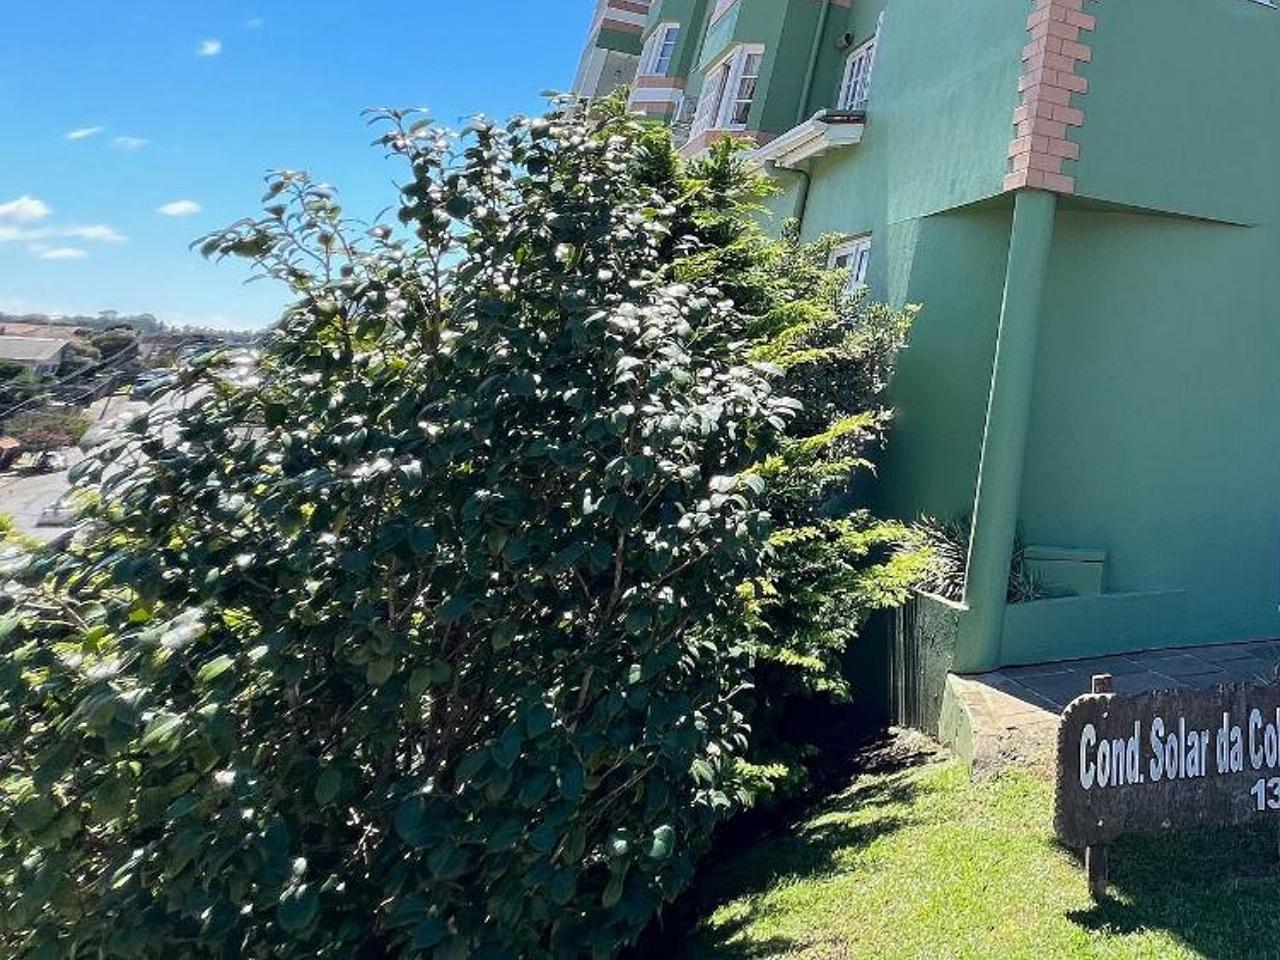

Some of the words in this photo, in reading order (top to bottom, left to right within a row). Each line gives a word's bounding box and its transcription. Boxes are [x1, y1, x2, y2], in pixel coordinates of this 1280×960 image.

[1079, 720, 1145, 790] Cond.
[1149, 716, 1209, 782] Solar
[1216, 711, 1244, 774] da
